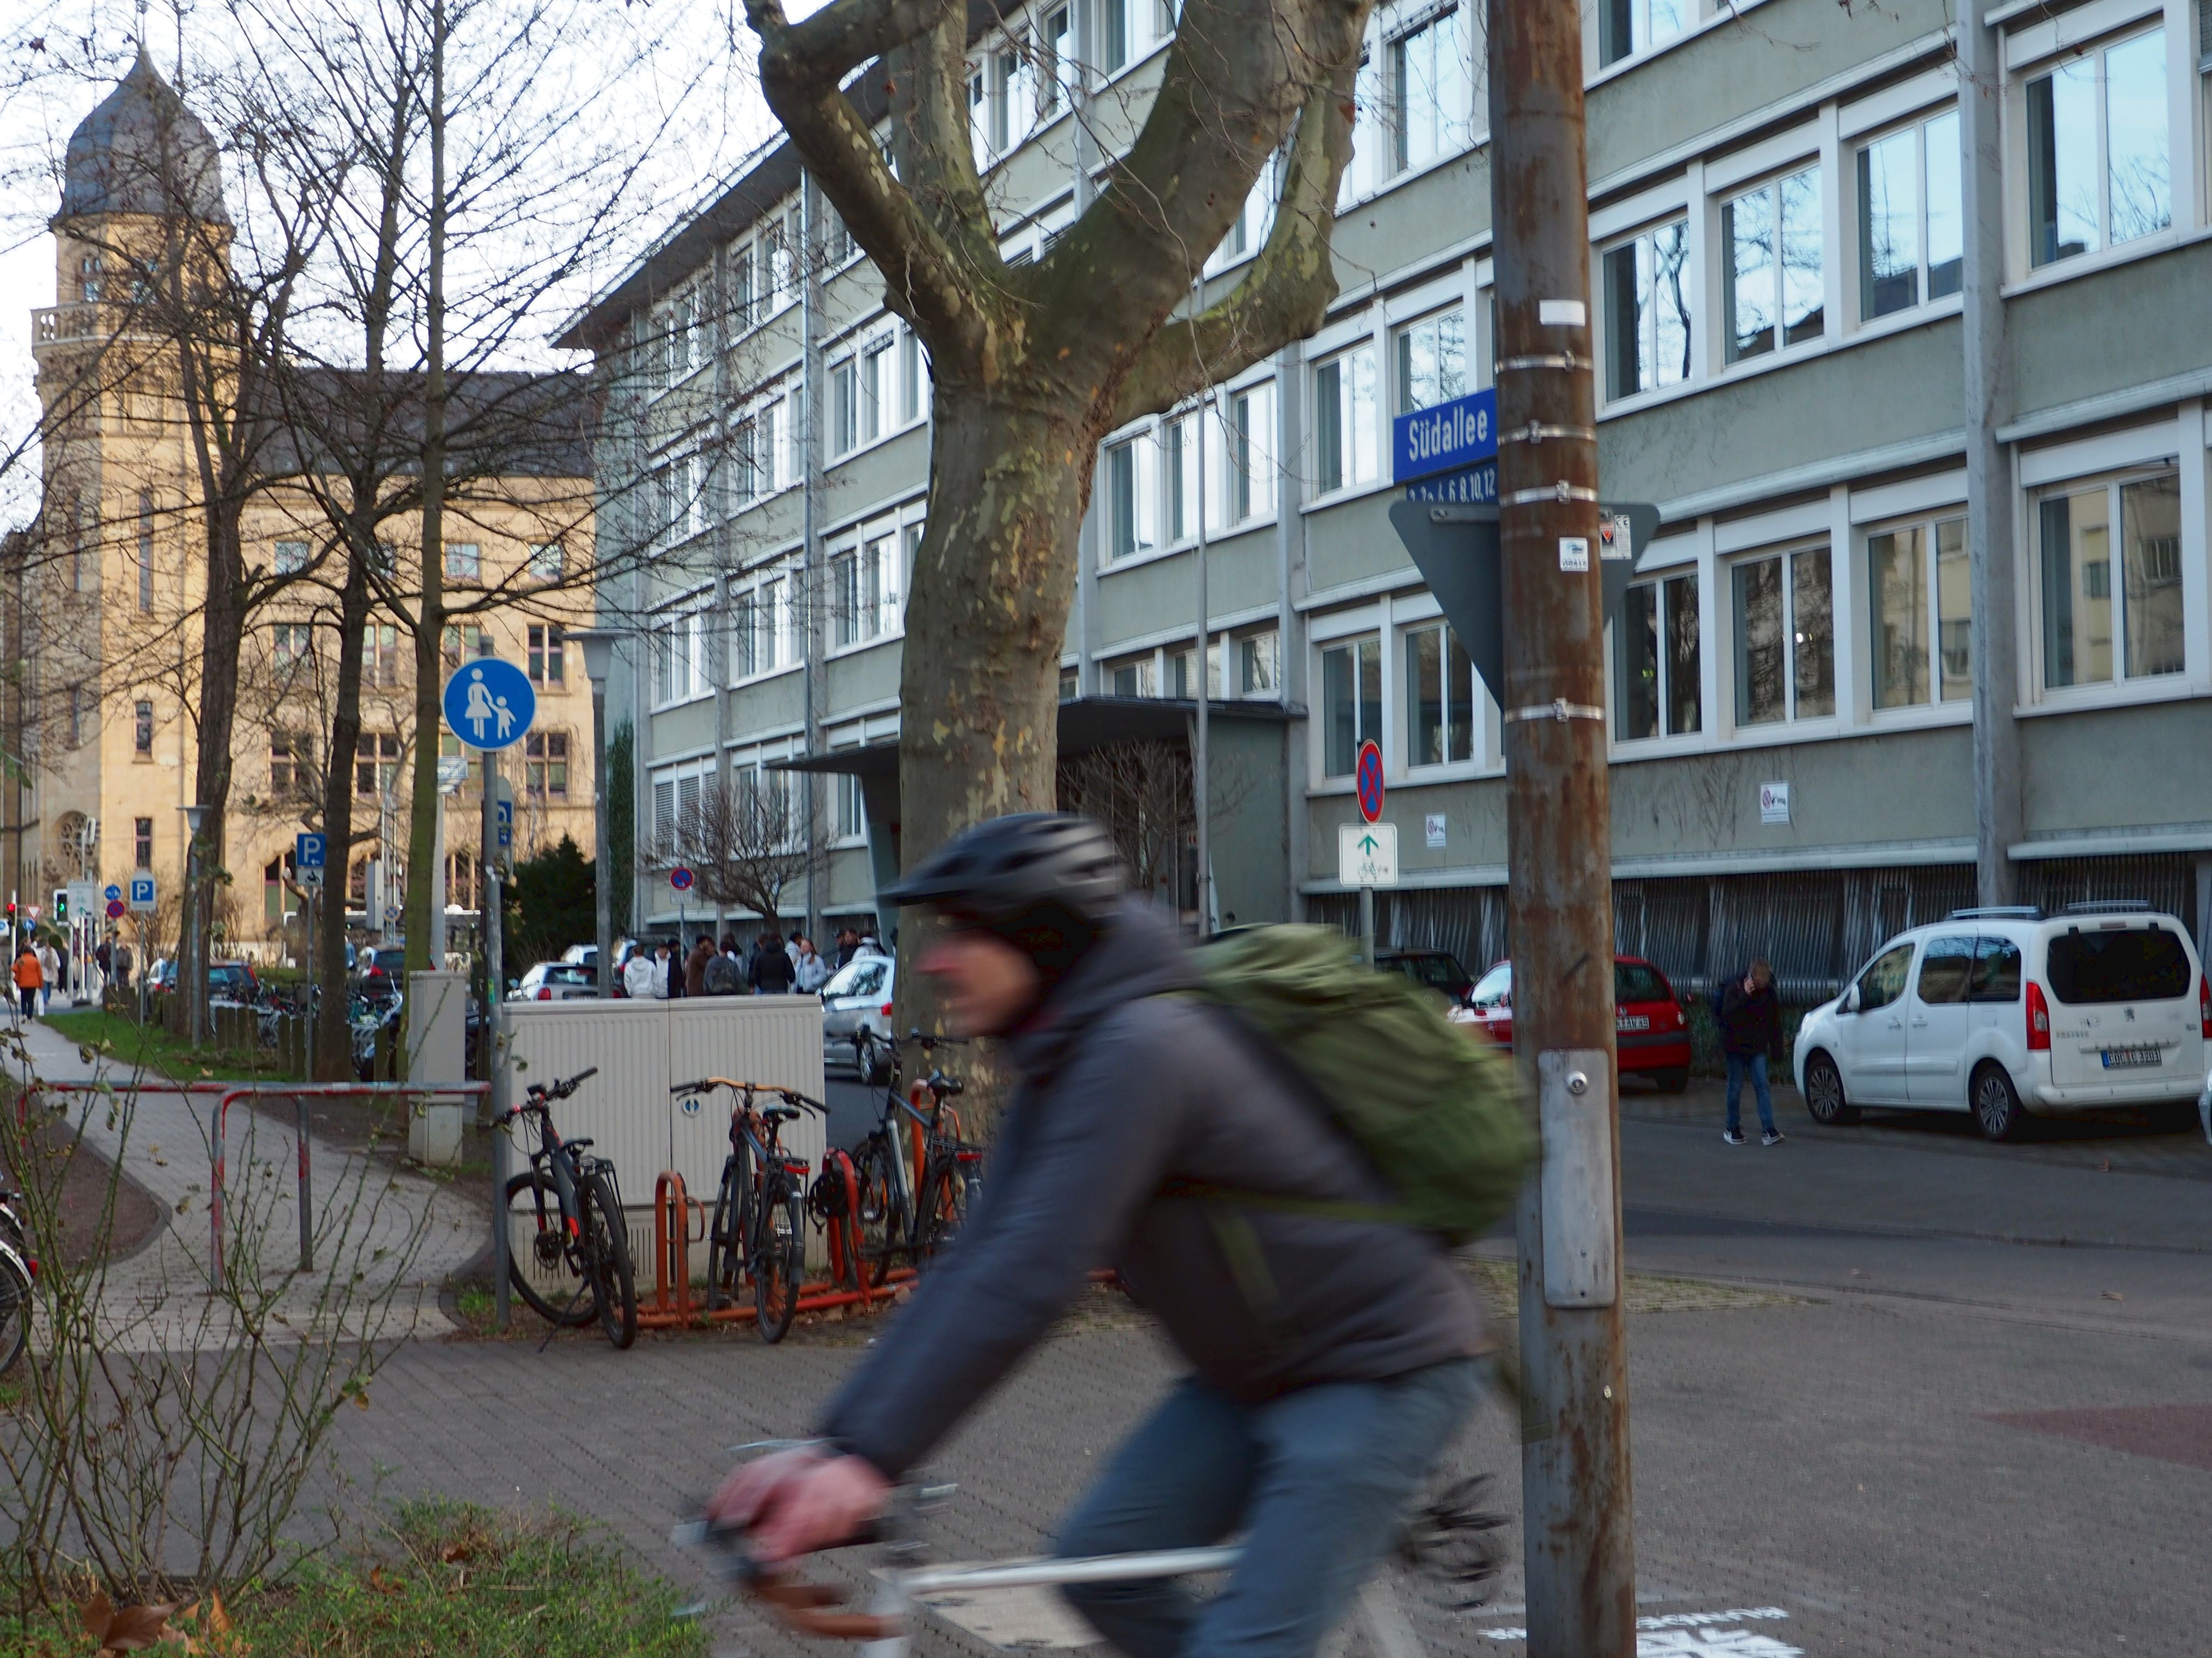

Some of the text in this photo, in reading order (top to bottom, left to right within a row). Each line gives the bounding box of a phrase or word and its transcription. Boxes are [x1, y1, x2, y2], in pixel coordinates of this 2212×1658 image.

[1409, 404, 1488, 462] Südallee
[304, 836, 321, 863] P
[136, 882, 149, 900] P
